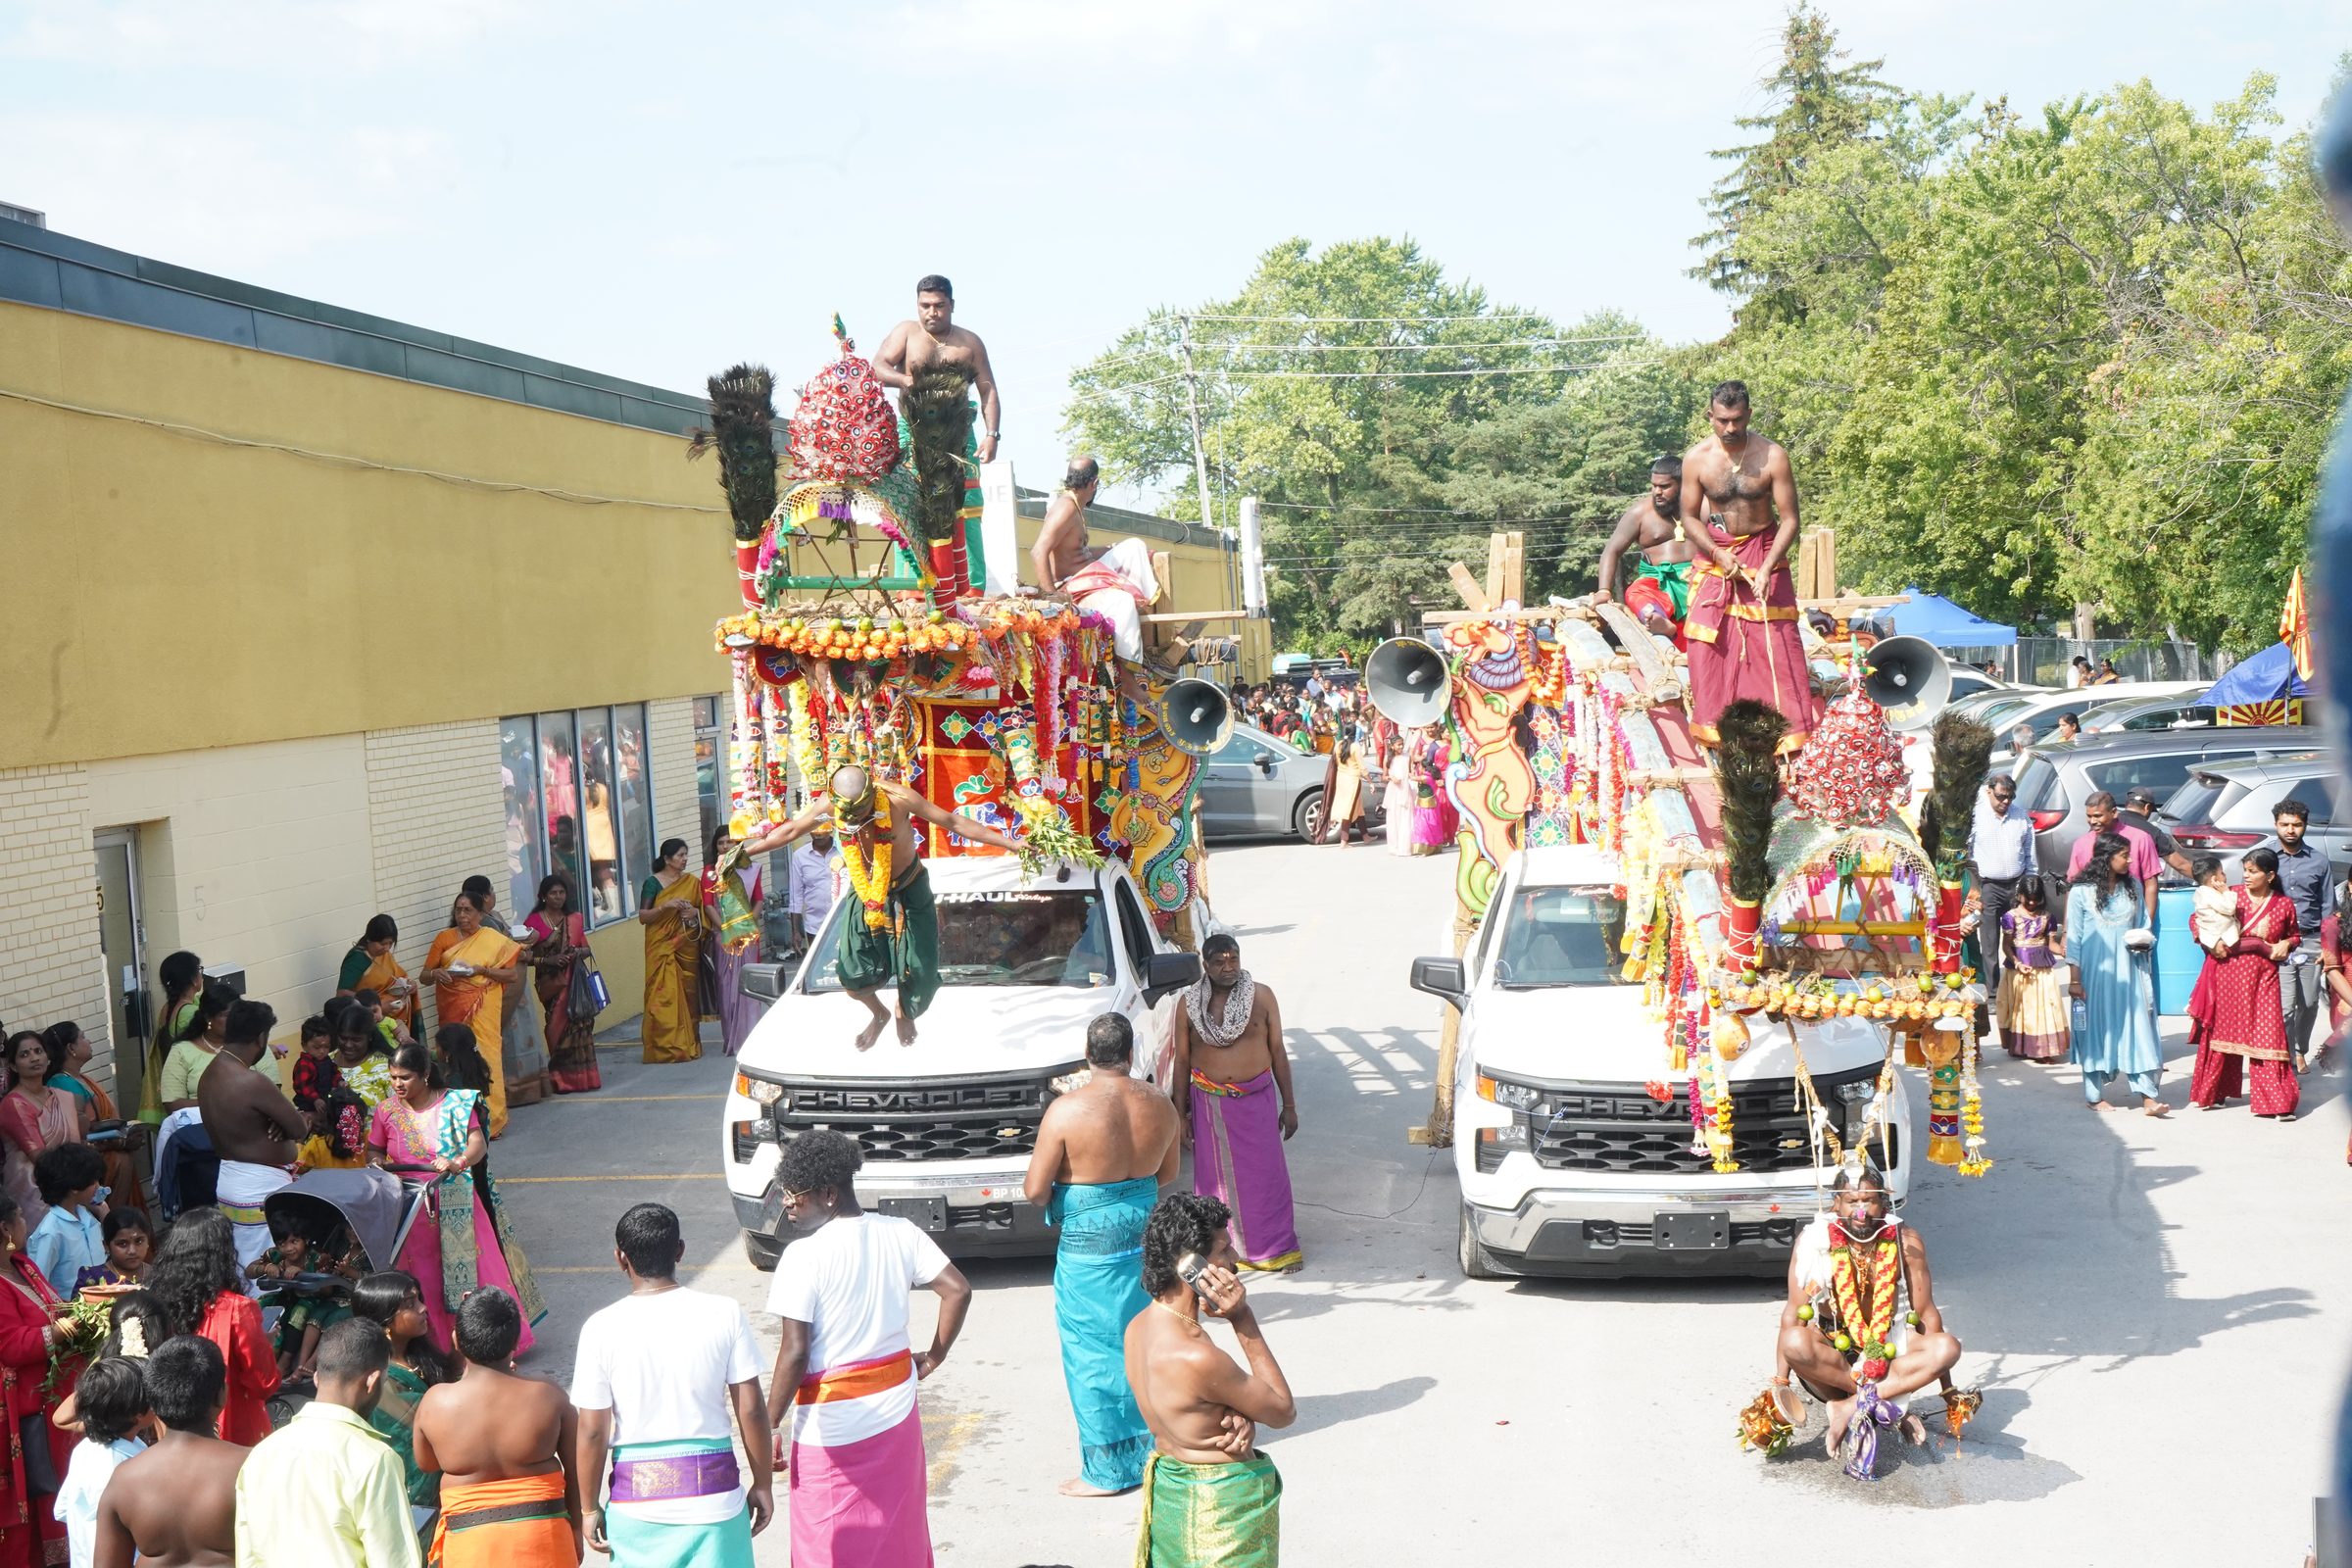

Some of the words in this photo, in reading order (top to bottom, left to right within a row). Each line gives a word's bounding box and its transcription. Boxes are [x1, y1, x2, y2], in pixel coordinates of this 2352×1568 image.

[793, 1085, 1037, 1108] CHEVROLET
[1554, 1094, 1809, 1115] CHEVLE
[993, 1188, 1007, 1199] BP
[1010, 1187, 1025, 1199] 10
